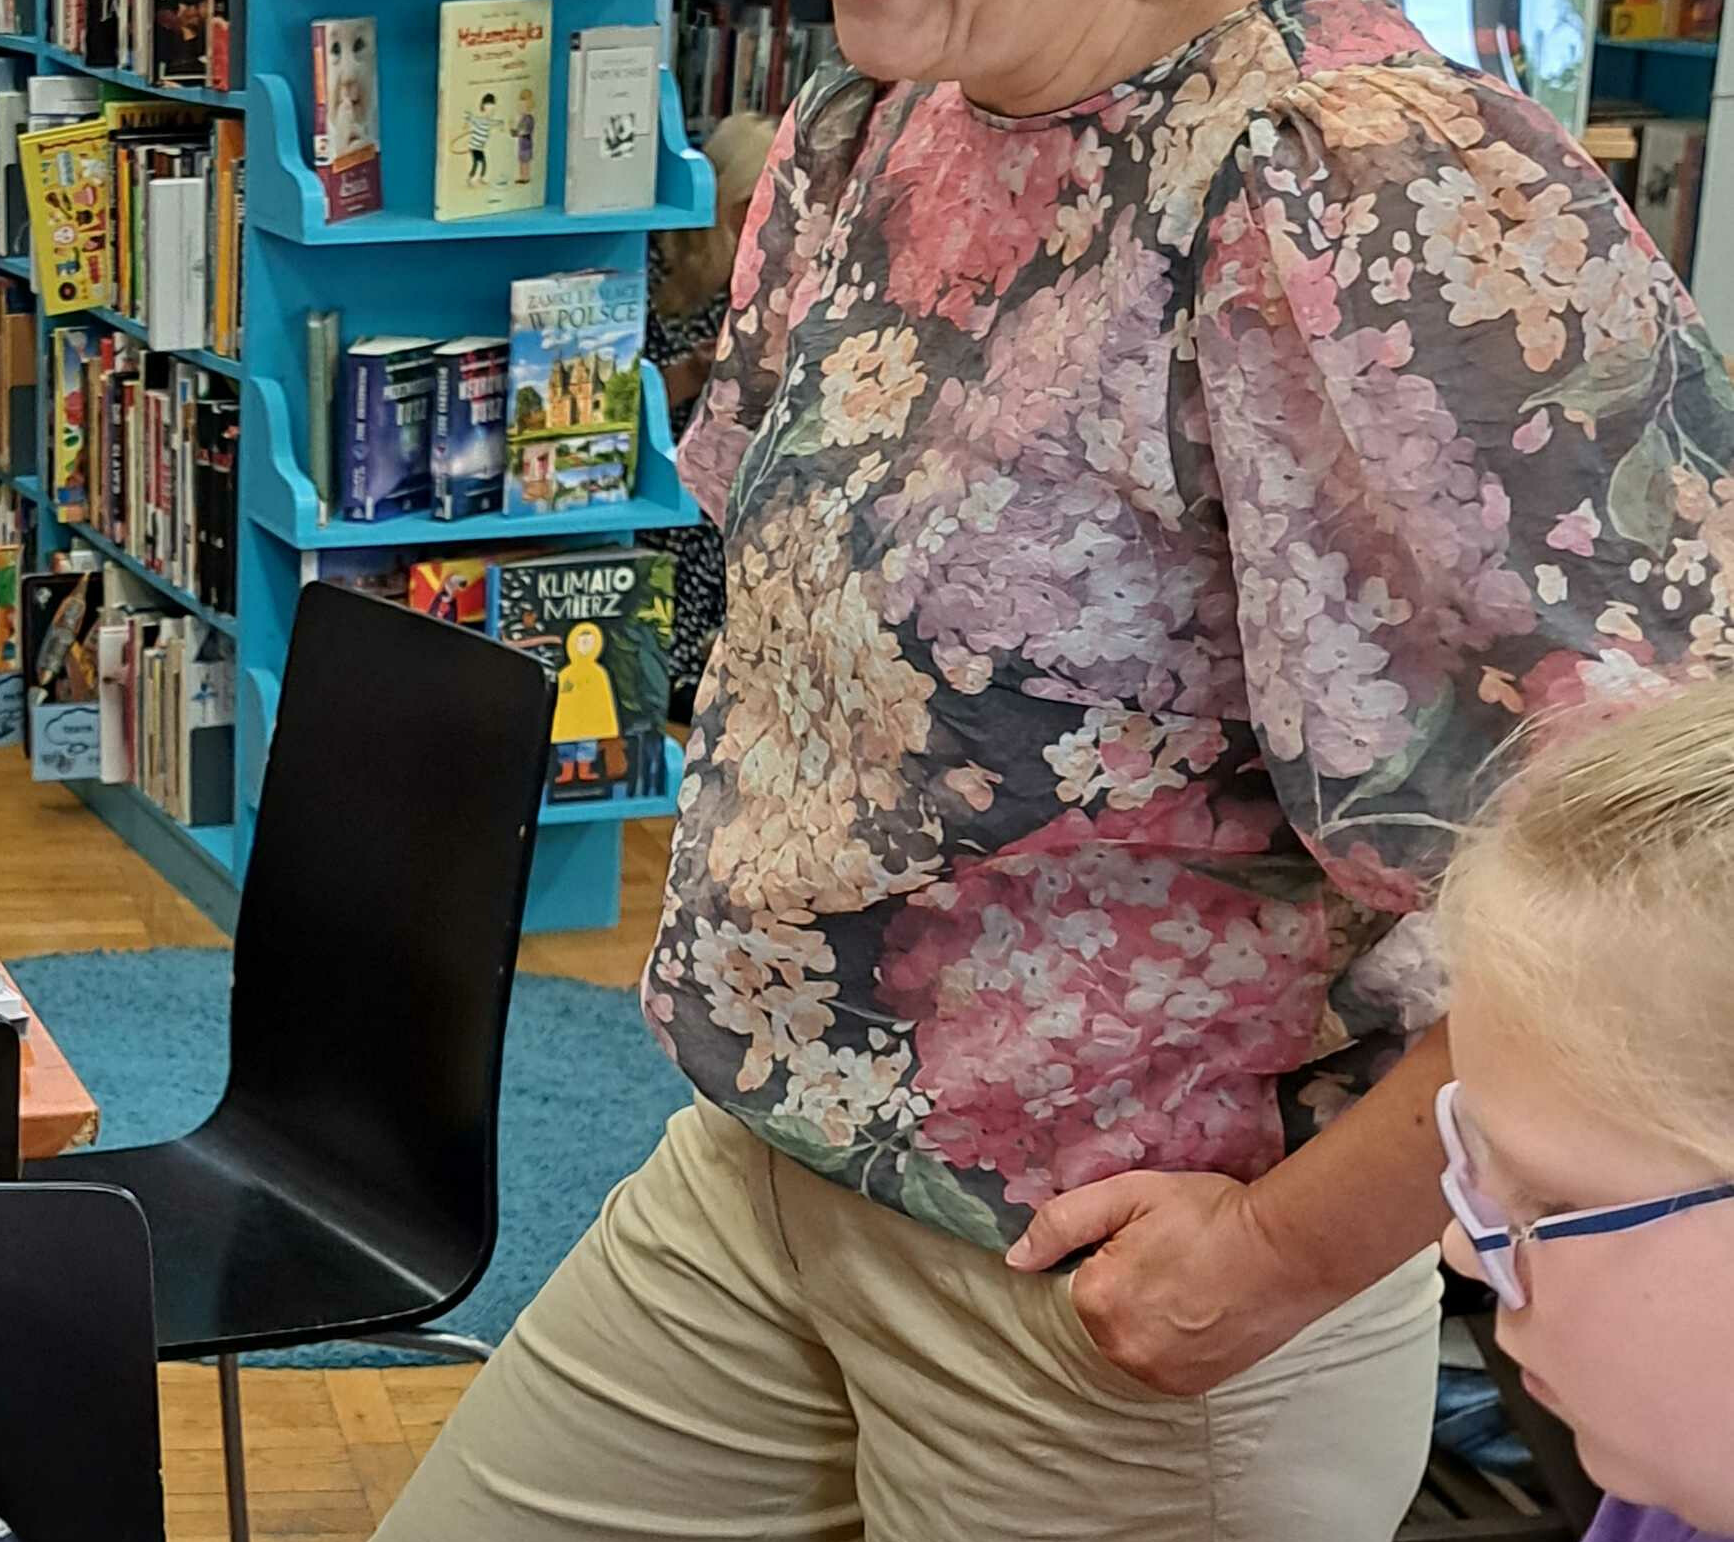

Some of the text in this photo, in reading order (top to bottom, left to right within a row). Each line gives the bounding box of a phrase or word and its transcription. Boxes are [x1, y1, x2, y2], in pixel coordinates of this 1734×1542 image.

[529, 303, 638, 331] W POLSCE
[538, 566, 635, 597] KLIMATO
[543, 595, 623, 621] MIERZ
